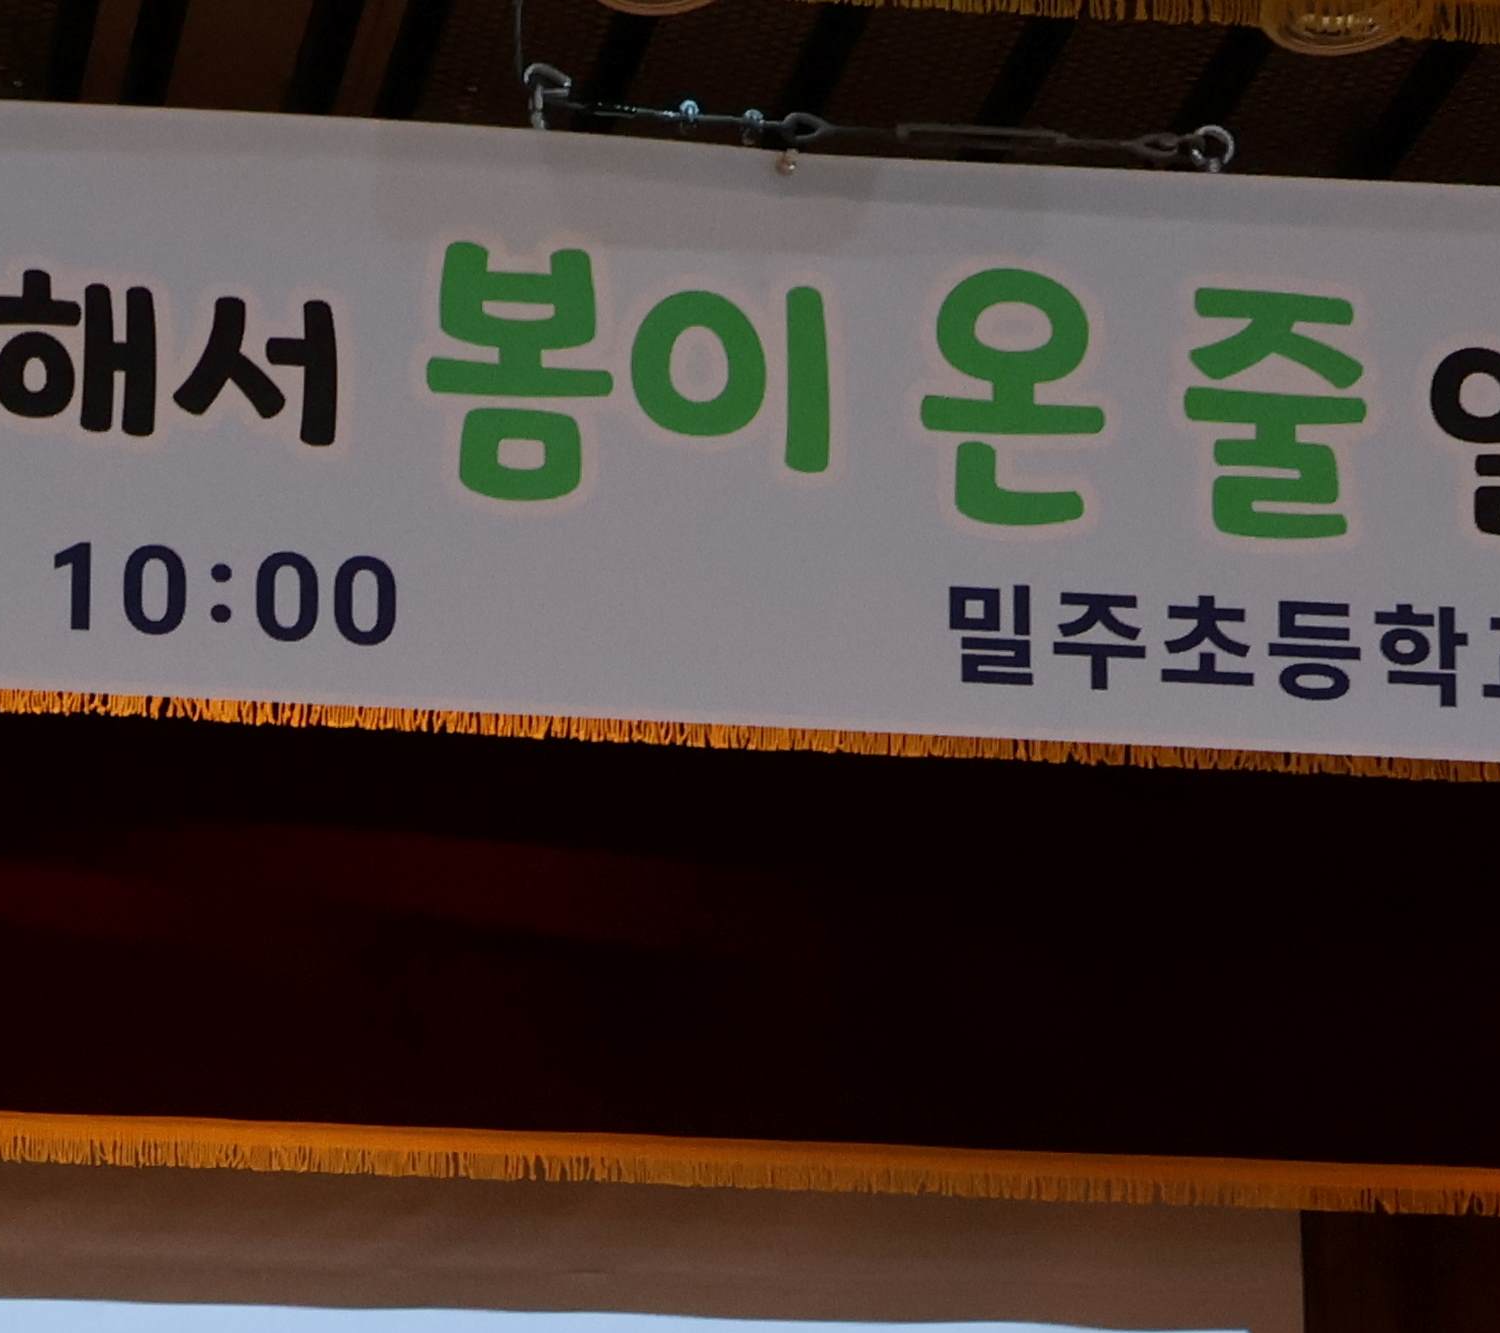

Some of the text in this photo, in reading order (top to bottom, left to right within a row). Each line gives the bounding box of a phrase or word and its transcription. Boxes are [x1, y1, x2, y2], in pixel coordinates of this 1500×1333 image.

[426, 241, 831, 502] 봄이
[921, 268, 1105, 526] 온
[1183, 287, 1367, 539] 줄
[55, 542, 397, 646] 10:00
